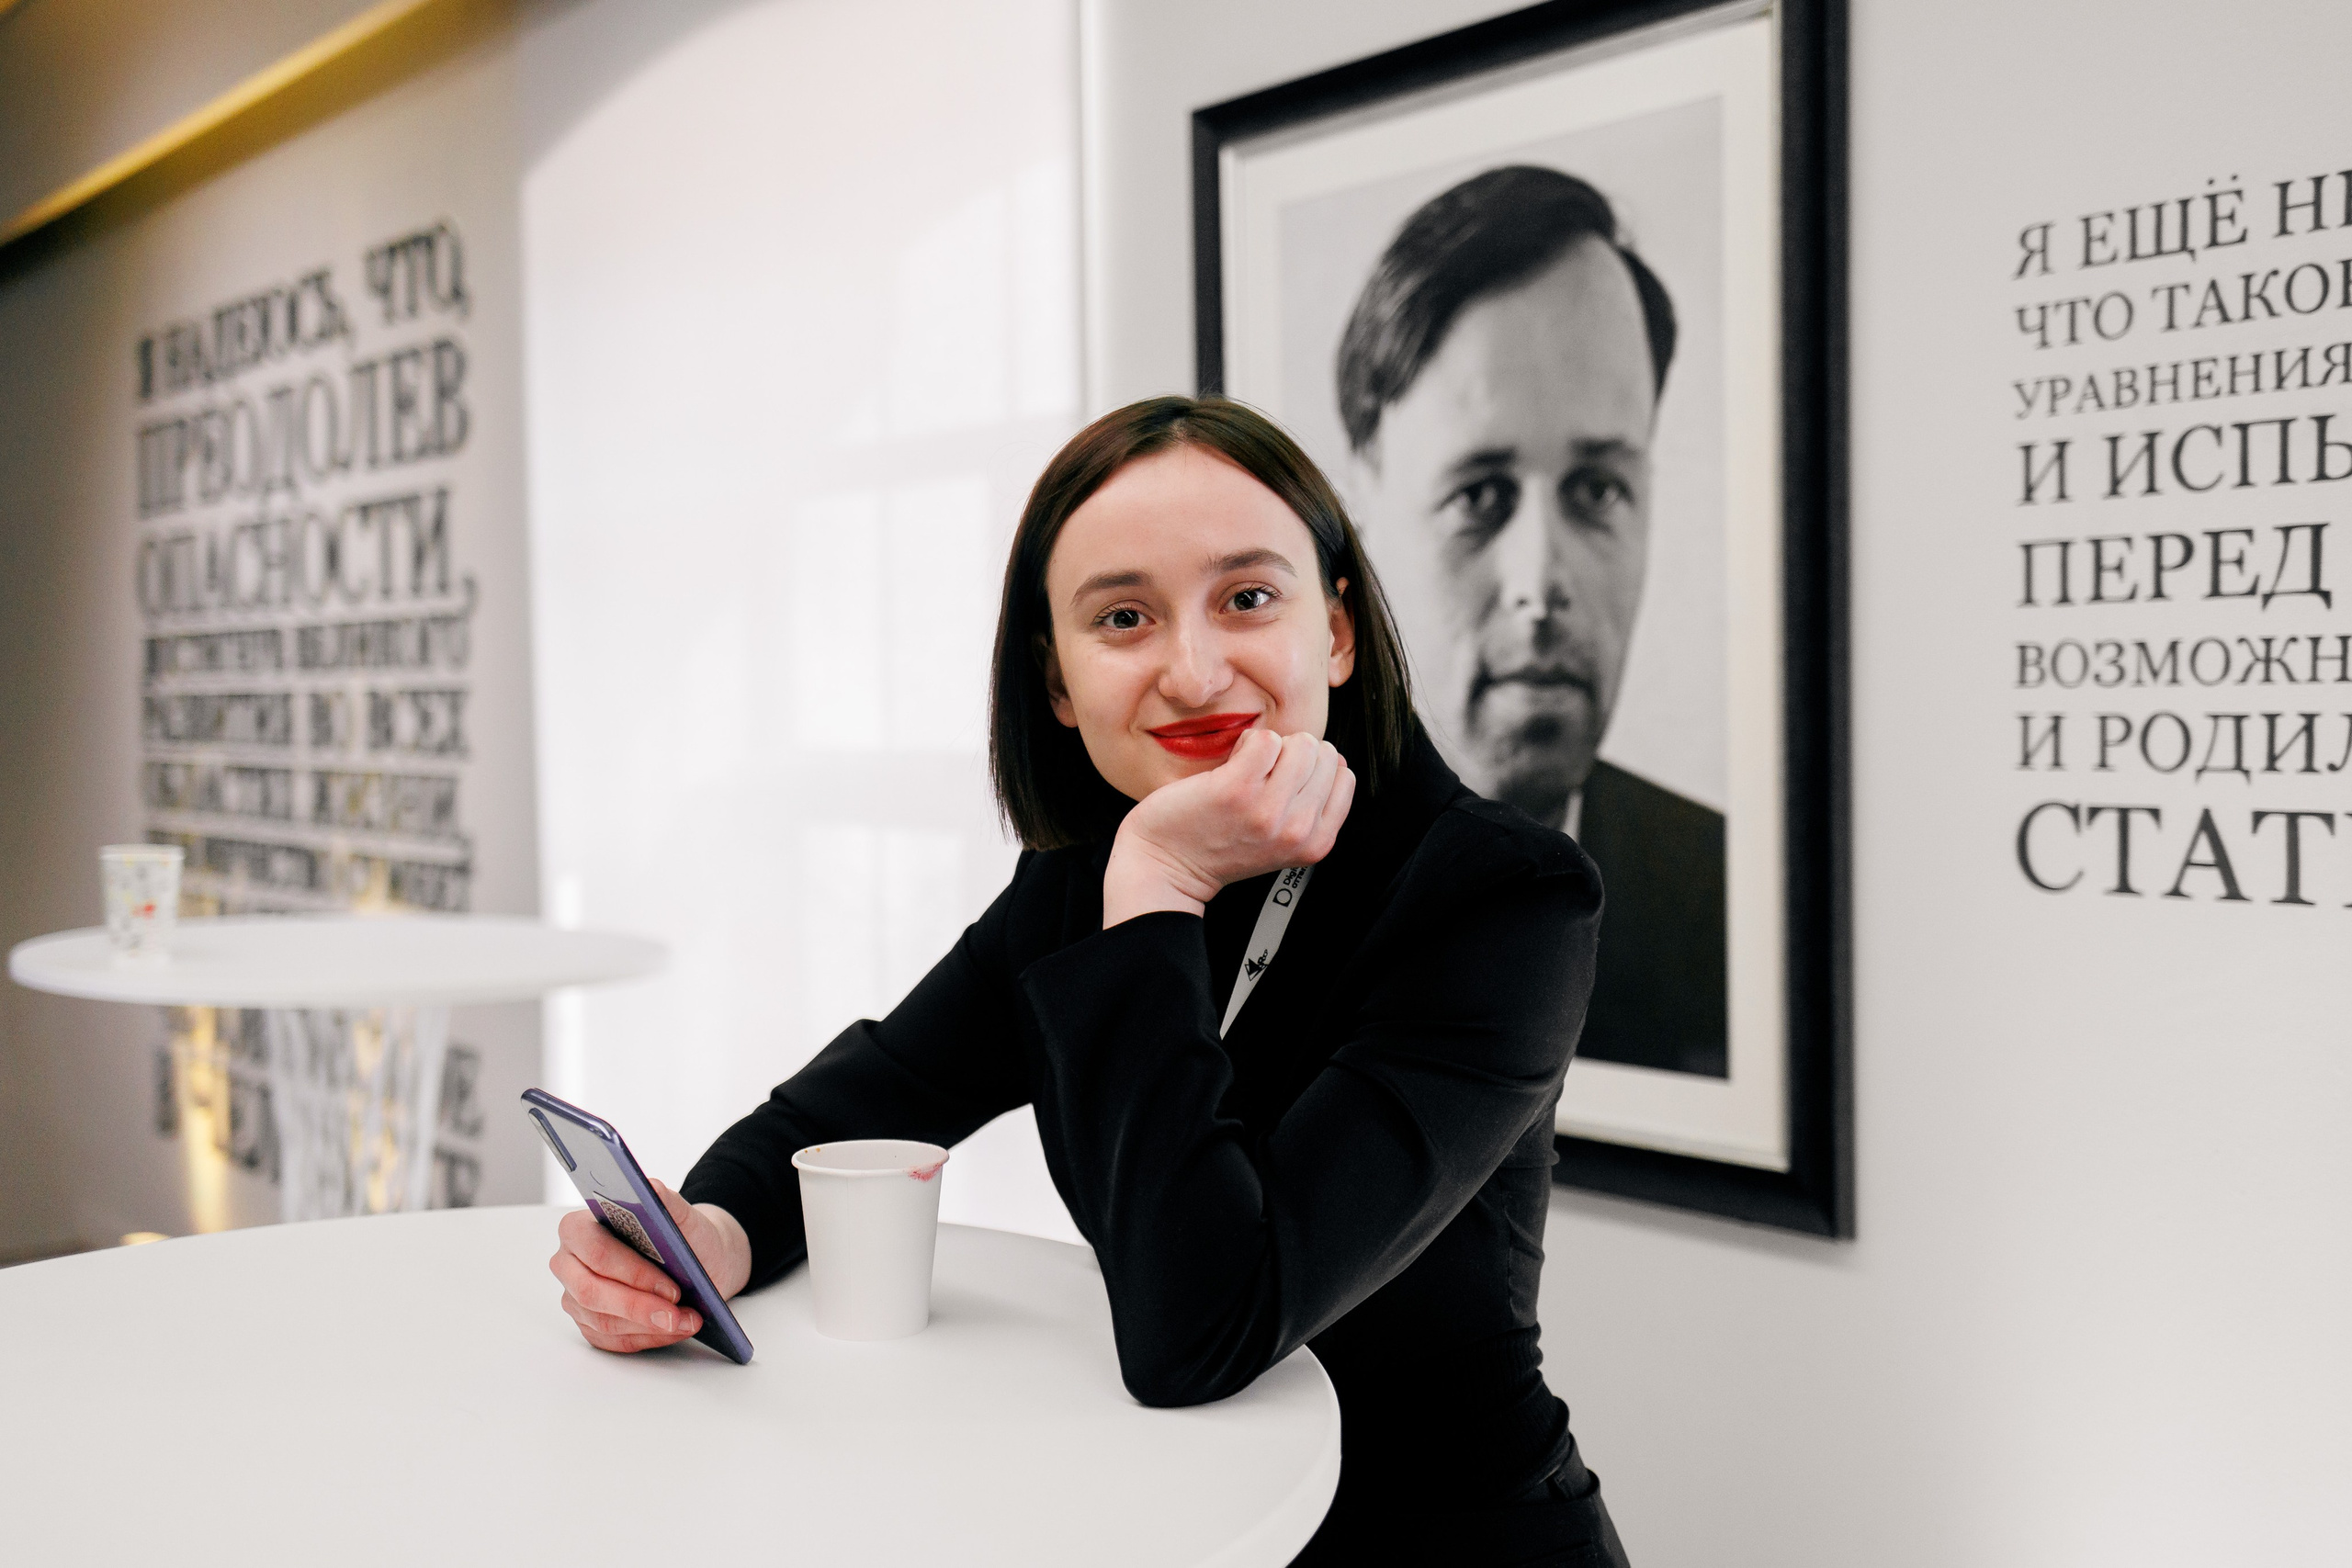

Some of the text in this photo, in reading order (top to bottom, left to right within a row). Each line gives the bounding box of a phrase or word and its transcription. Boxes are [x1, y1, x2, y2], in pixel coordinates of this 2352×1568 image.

[2012, 220, 2056, 279] Я
[2077, 173, 2248, 270] ЕЩЁ
[2015, 288, 2133, 351] ЧТО
[2012, 341, 2352, 420] УРАВНЕНИЯ
[2016, 439, 2073, 505] И
[2015, 521, 2334, 614] ПЕРЕД
[2016, 711, 2064, 772] И
[2015, 799, 2352, 909] СТАТ
